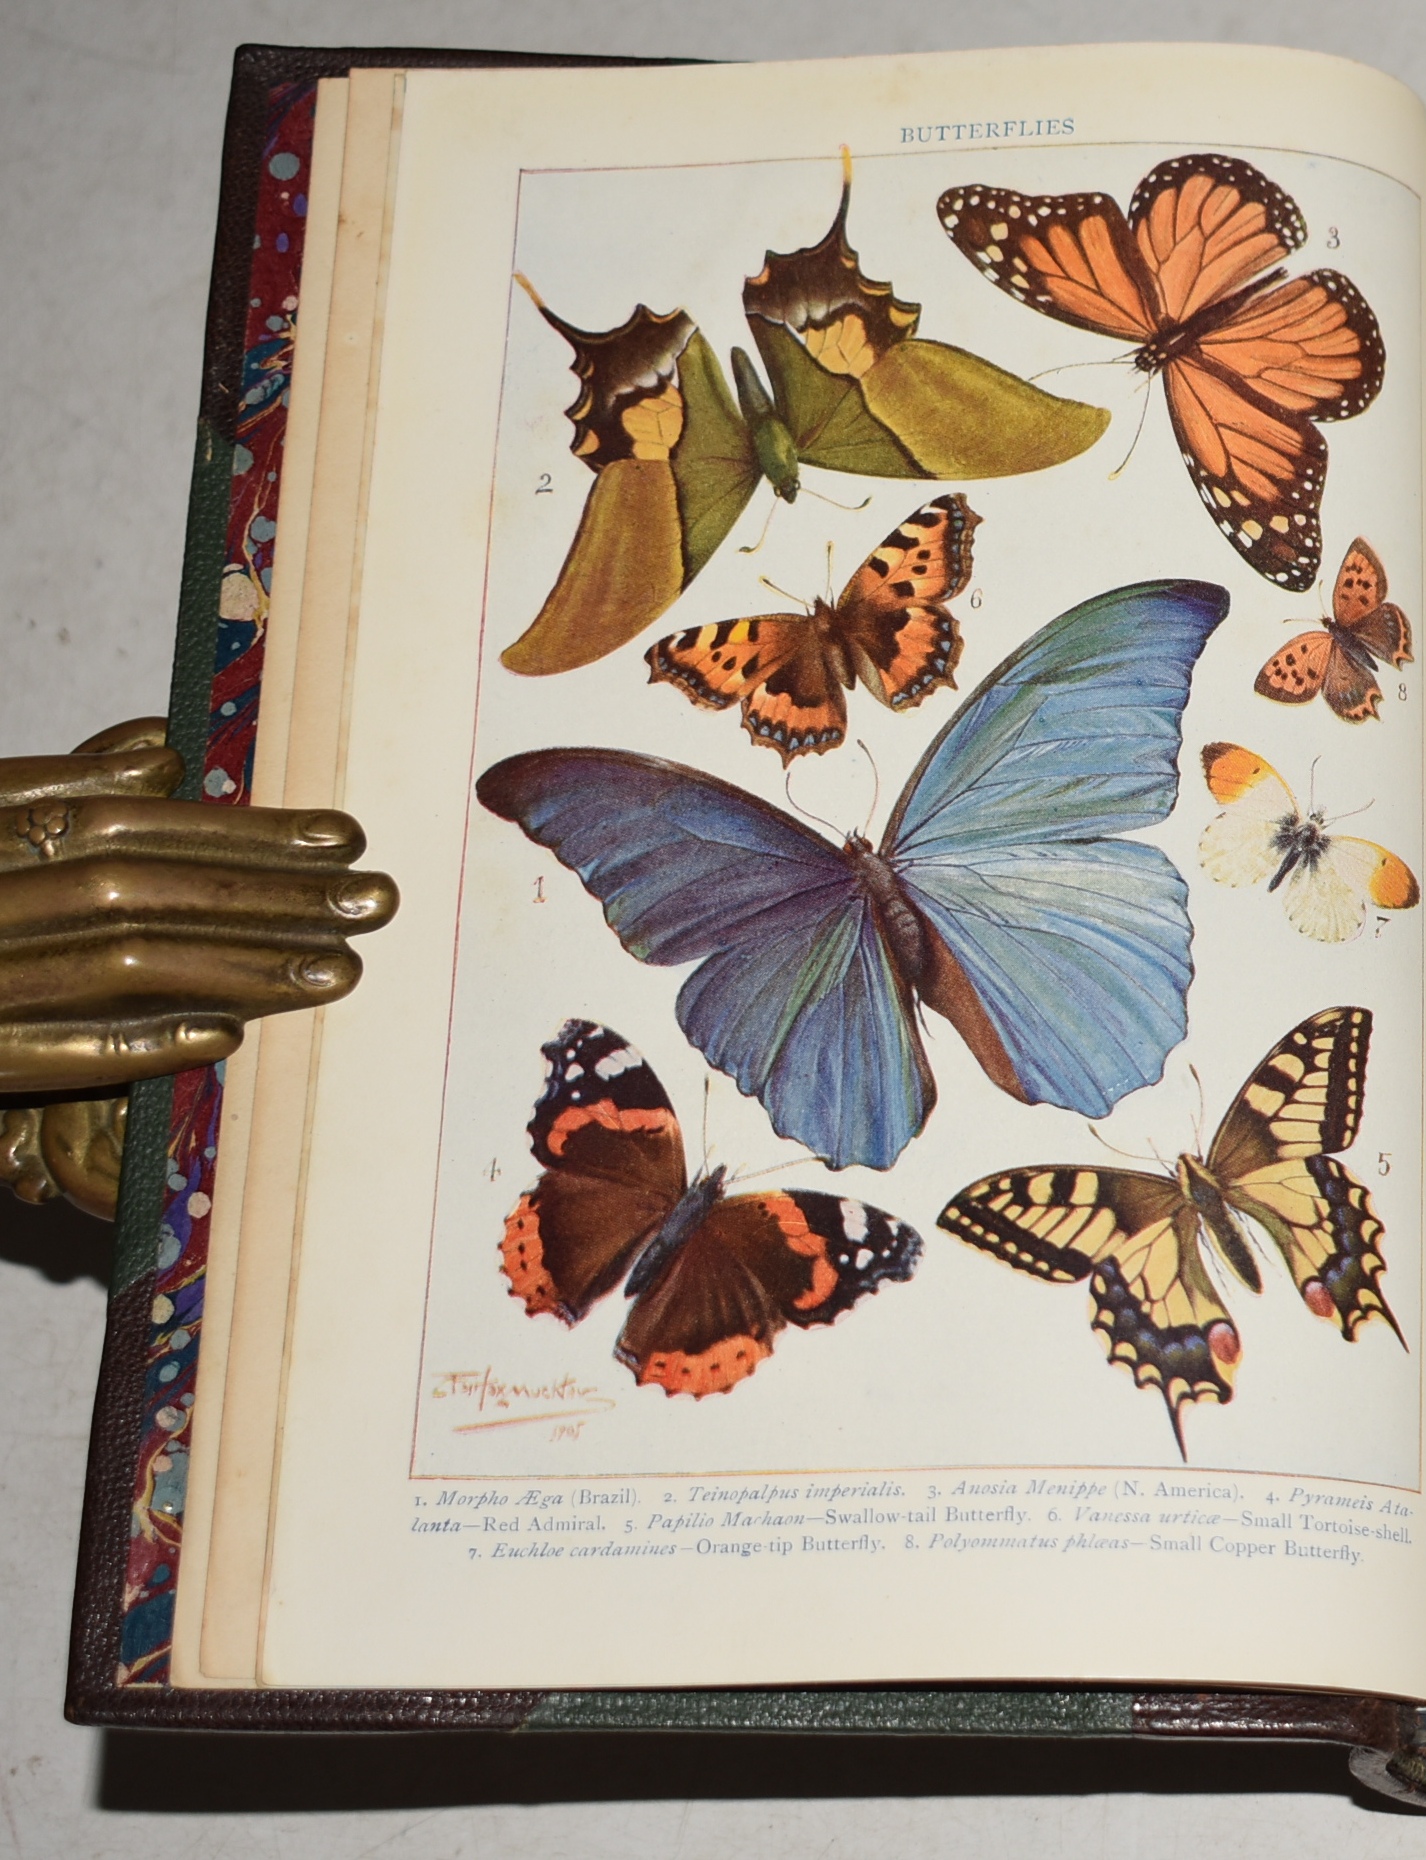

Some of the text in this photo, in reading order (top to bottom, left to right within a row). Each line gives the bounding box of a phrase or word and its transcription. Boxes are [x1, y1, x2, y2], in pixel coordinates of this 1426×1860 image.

[900, 117, 1075, 144] BUTTERFLIES
[1327, 226, 1340, 249] 3
[535, 473, 553, 495] 2
[970, 587, 984, 609] 6
[1398, 682, 1408, 702] 8
[532, 874, 547, 904] 1
[1374, 915, 1392, 939] 7
[481, 1156, 502, 1182] 4
[1378, 1151, 1392, 1177] 5
[435, 1490, 509, 1510] Morpho
[514, 1489, 564, 1510] Æga
[571, 1487, 641, 1507] (Brazil).
[663, 1492, 677, 1503] 2.
[688, 1483, 800, 1505] Teinopalpus
[805, 1480, 906, 1503] imperialis.
[927, 1485, 942, 1500] 3.
[950, 1479, 1017, 1496] Anosia
[1025, 1479, 1107, 1500] Menippe
[1114, 1480, 1145, 1500] (N.
[1153, 1481, 1245, 1503] America).
[1265, 1491, 1280, 1505] 4.
[1288, 1487, 1374, 1511] Pyrameis
[526, 1514, 606, 1532] Admiral.
[623, 1519, 638, 1534] 5.
[647, 1512, 715, 1533] Papilio
[944, 1505, 1032, 1526] Butterfly.
[1047, 1507, 1062, 1522] 6.
[1074, 1506, 1151, 1524] Vanessa
[1299, 1510, 1413, 1545] Tortoise-shell.
[468, 1547, 482, 1560] 7.
[490, 1541, 565, 1558] Euchloe
[801, 1533, 886, 1554] Butterfly.
[904, 1533, 920, 1550] 8.
[927, 1532, 1059, 1553] Polyommatus
[1209, 1535, 1277, 1558] Copper
[1284, 1539, 1365, 1566] Butterfly.
